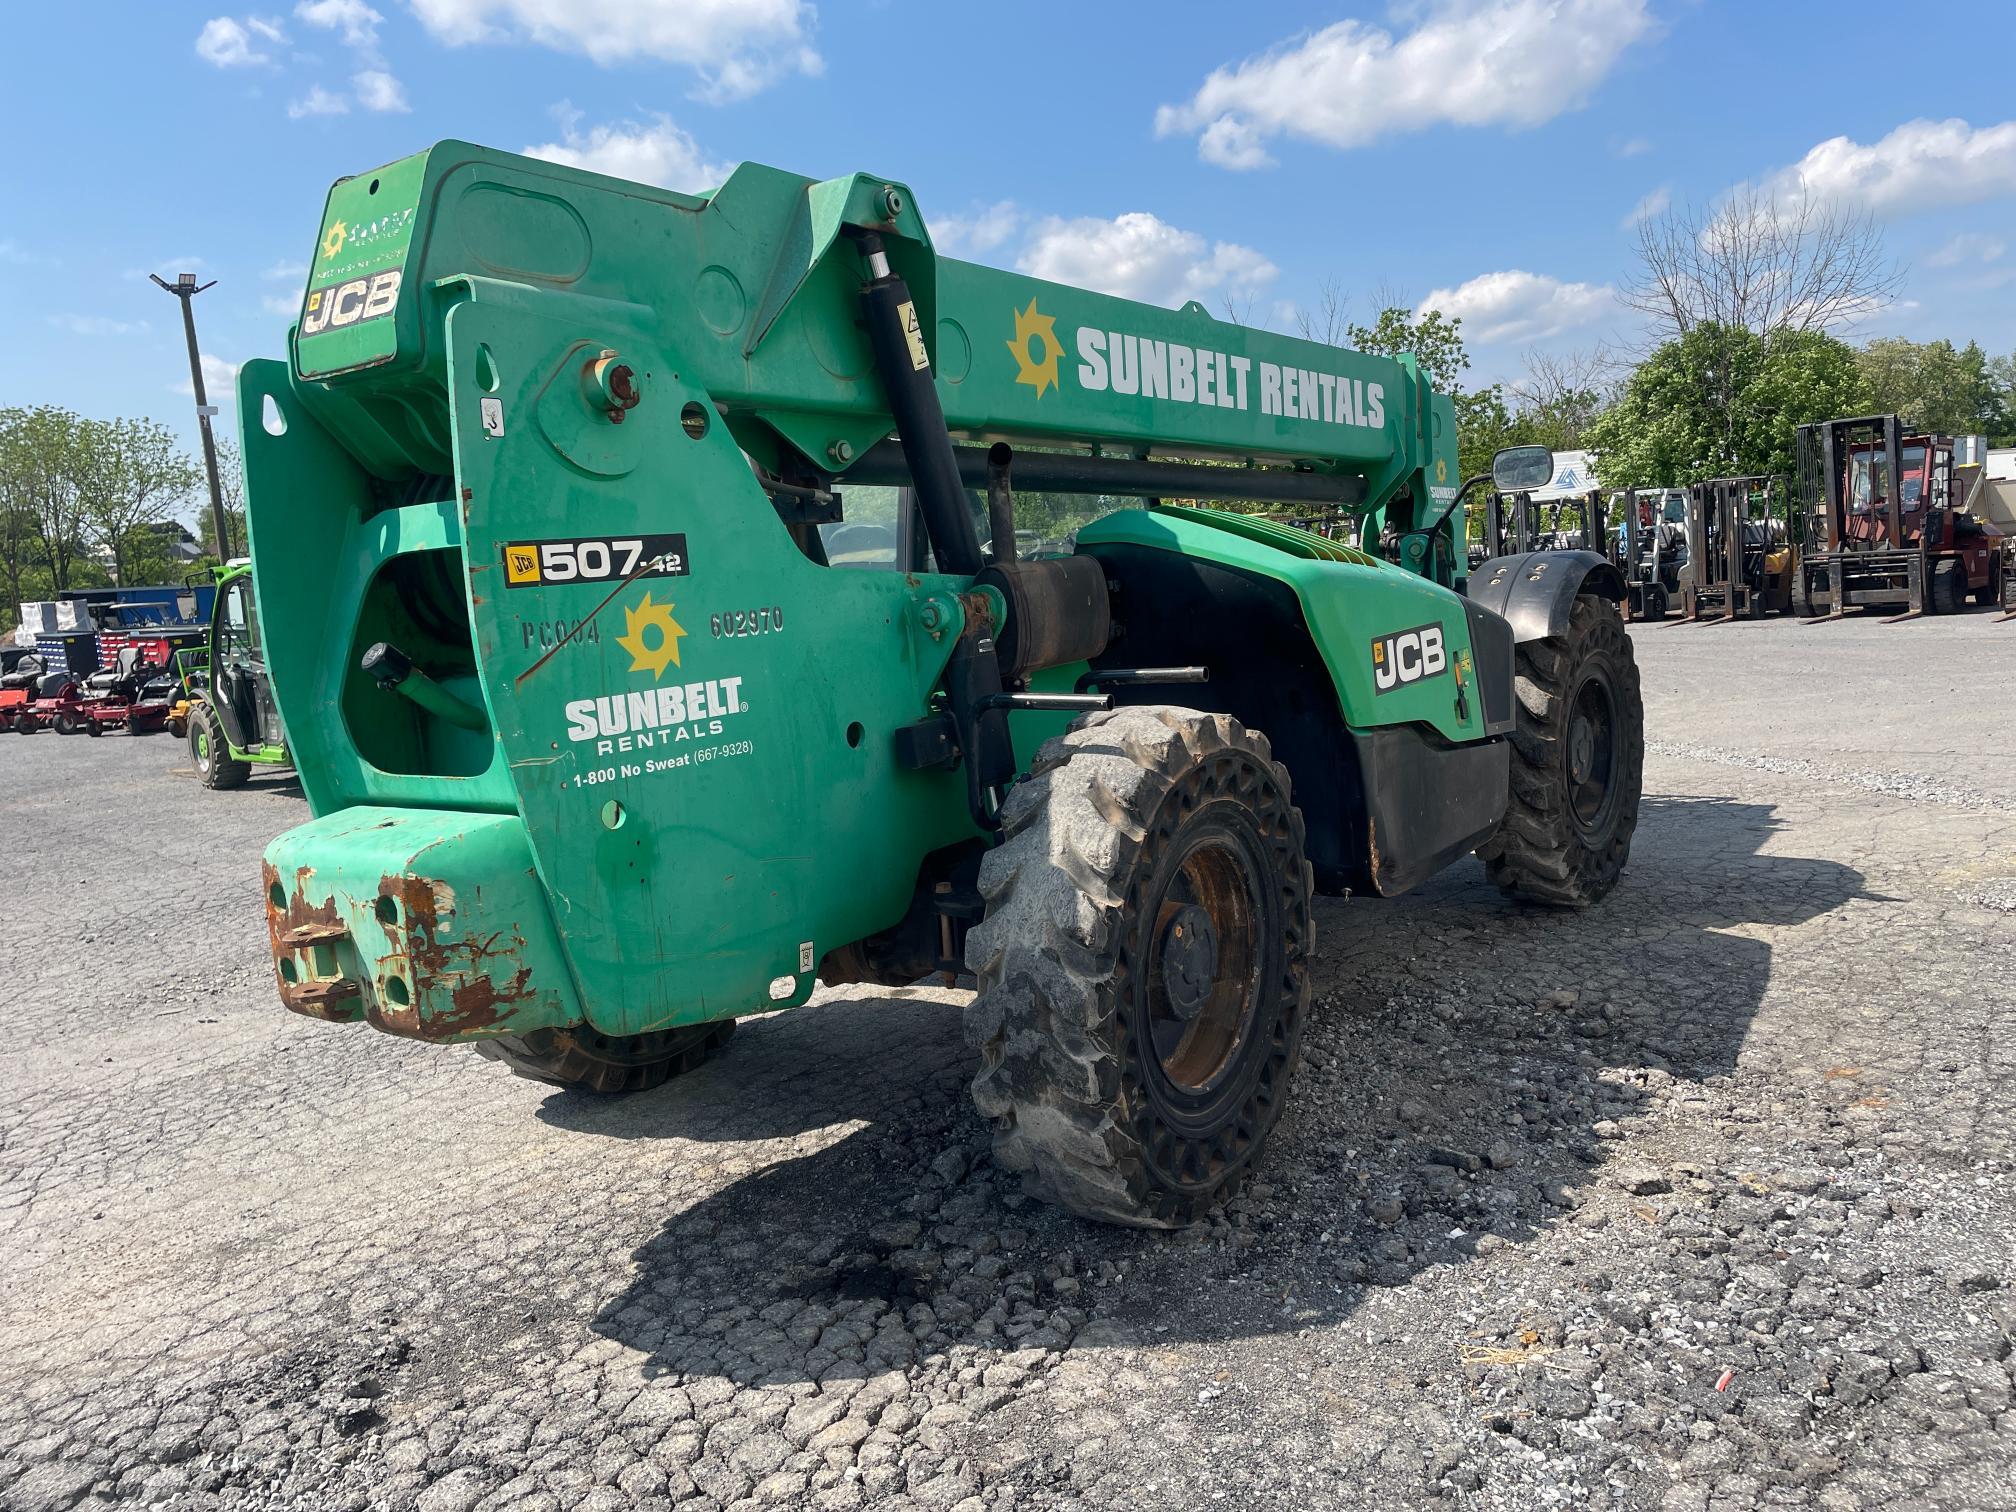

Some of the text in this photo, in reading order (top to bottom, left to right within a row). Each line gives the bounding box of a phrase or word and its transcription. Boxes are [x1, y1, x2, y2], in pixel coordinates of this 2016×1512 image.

[304, 271, 401, 333] JCB
[1077, 327, 1385, 429] SUNBELT RENTALS
[515, 557, 535, 573] JCB
[710, 606, 784, 639] 602970
[1376, 627, 1445, 689] JCB
[597, 720, 723, 756] RENTALS
[573, 740, 753, 788] 1-800 No Sweat (667-9328)
